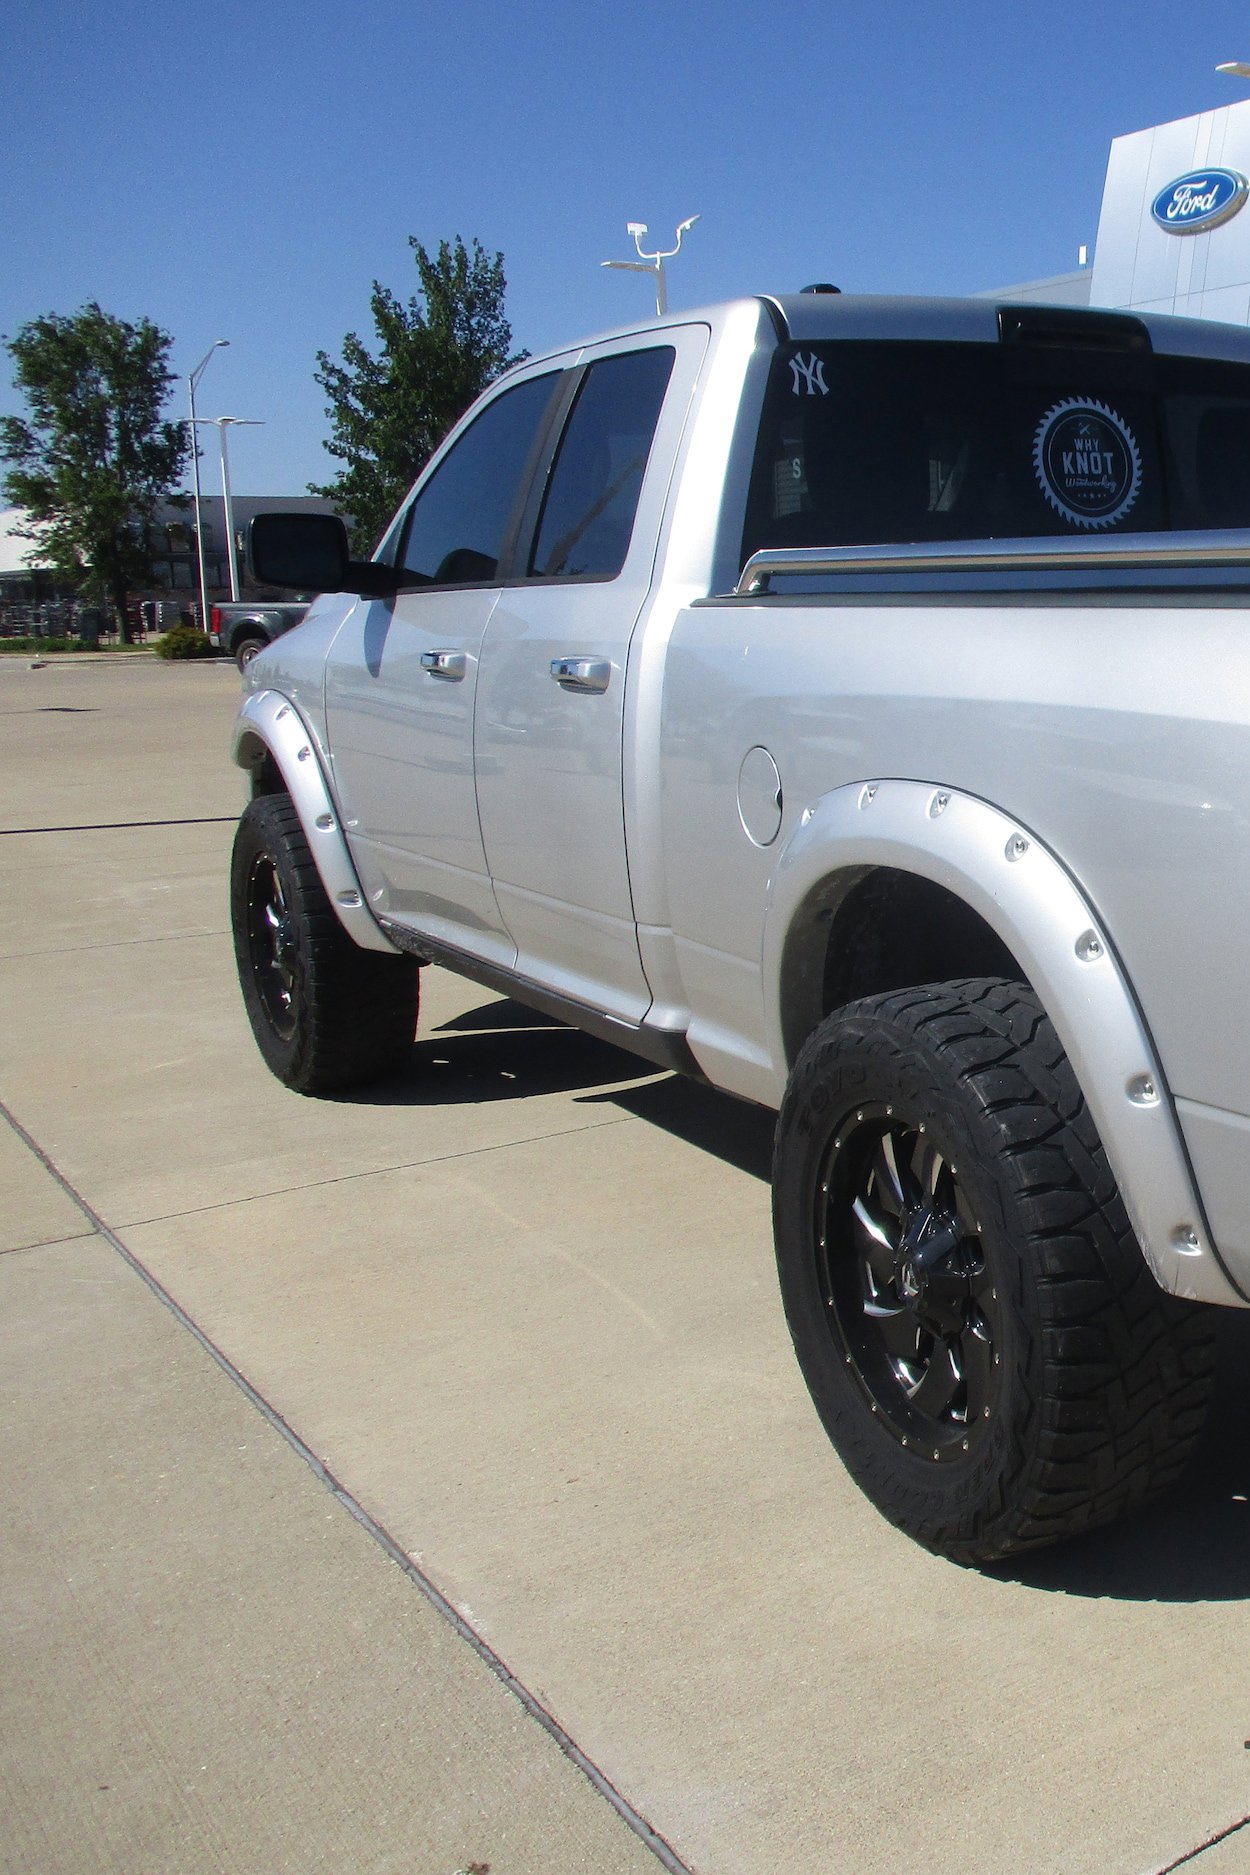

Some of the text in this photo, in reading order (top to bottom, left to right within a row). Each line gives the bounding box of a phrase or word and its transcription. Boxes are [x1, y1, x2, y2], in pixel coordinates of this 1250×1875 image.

[1166, 180, 1220, 219] Ford
[1074, 438, 1100, 452] WHY
[1062, 451, 1114, 475] KNOT
